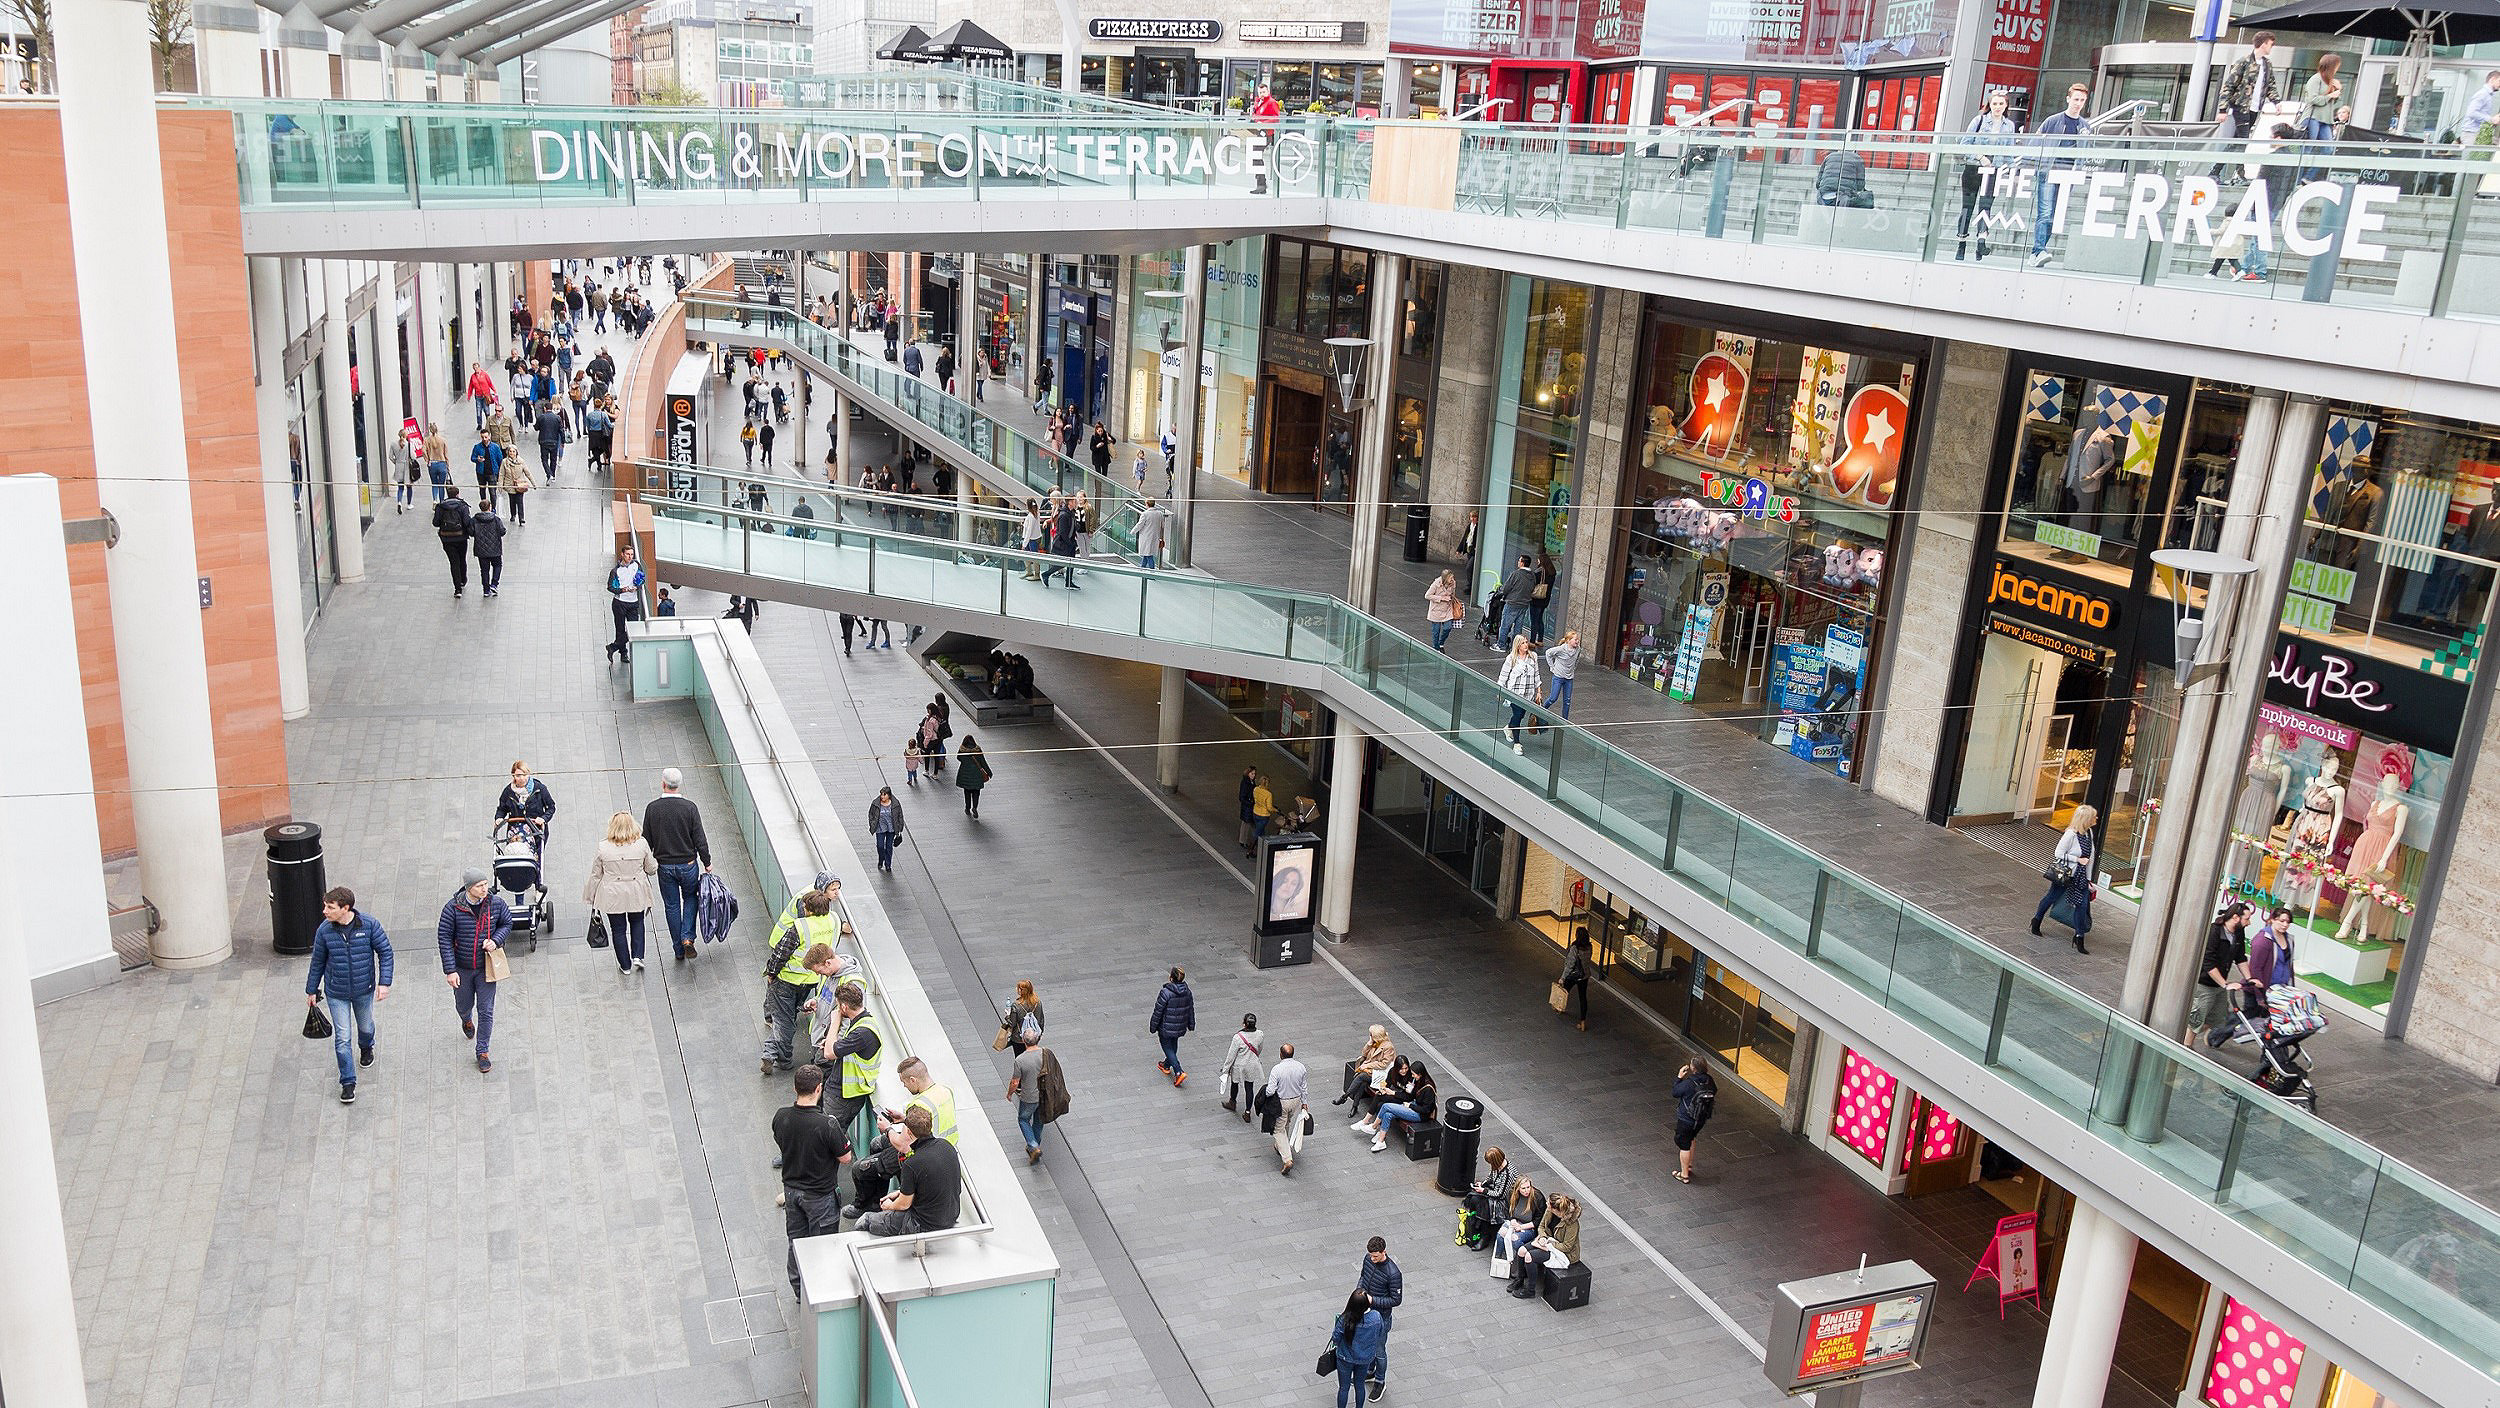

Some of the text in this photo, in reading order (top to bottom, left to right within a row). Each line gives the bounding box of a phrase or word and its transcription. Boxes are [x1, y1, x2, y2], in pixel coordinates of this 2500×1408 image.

[1513, 1, 1520, 10] A
[1777, 9, 1801, 17] ONE
[1594, 17, 1620, 39] GUYS
[1886, 3, 1933, 36] FRESH
[1992, 12, 2043, 42] GUYS
[1097, 20, 1209, 37] PIZZAEXPRESS
[1747, 21, 1802, 39] HIRING
[1484, 34, 1518, 44] JOINT
[1996, 41, 2030, 54] COMING SOON
[531, 130, 1266, 180] DINING & MORE ON THE TERRACE
[1978, 166, 2401, 261] THE TERRACE
[1219, 264, 1259, 289] Express
[1161, 351, 1181, 368] Optic
[2036, 522, 2066, 546] SIZES
[2290, 561, 2351, 599] CE DAY
[1988, 562, 2110, 629] jacamo
[2283, 595, 2332, 630] STYLE
[1993, 618, 2096, 662] www.jacamo.co.uk
[2268, 644, 2388, 711] lyBe
[2259, 707, 2348, 745] mplybe.co.uk
[1280, 940, 1293, 957] 1
[1423, 1139, 1433, 1152] 1
[1568, 1286, 1579, 1300] 1
[1816, 1319, 1861, 1334] CARPETS
[1819, 1310, 1863, 1326] UNITED
[1813, 1342, 1854, 1358] LAMINATE
[1819, 1335, 1851, 1348] CARPET
[1806, 1357, 1830, 1367] VINYL
[1837, 1350, 1857, 1361] BEDS
